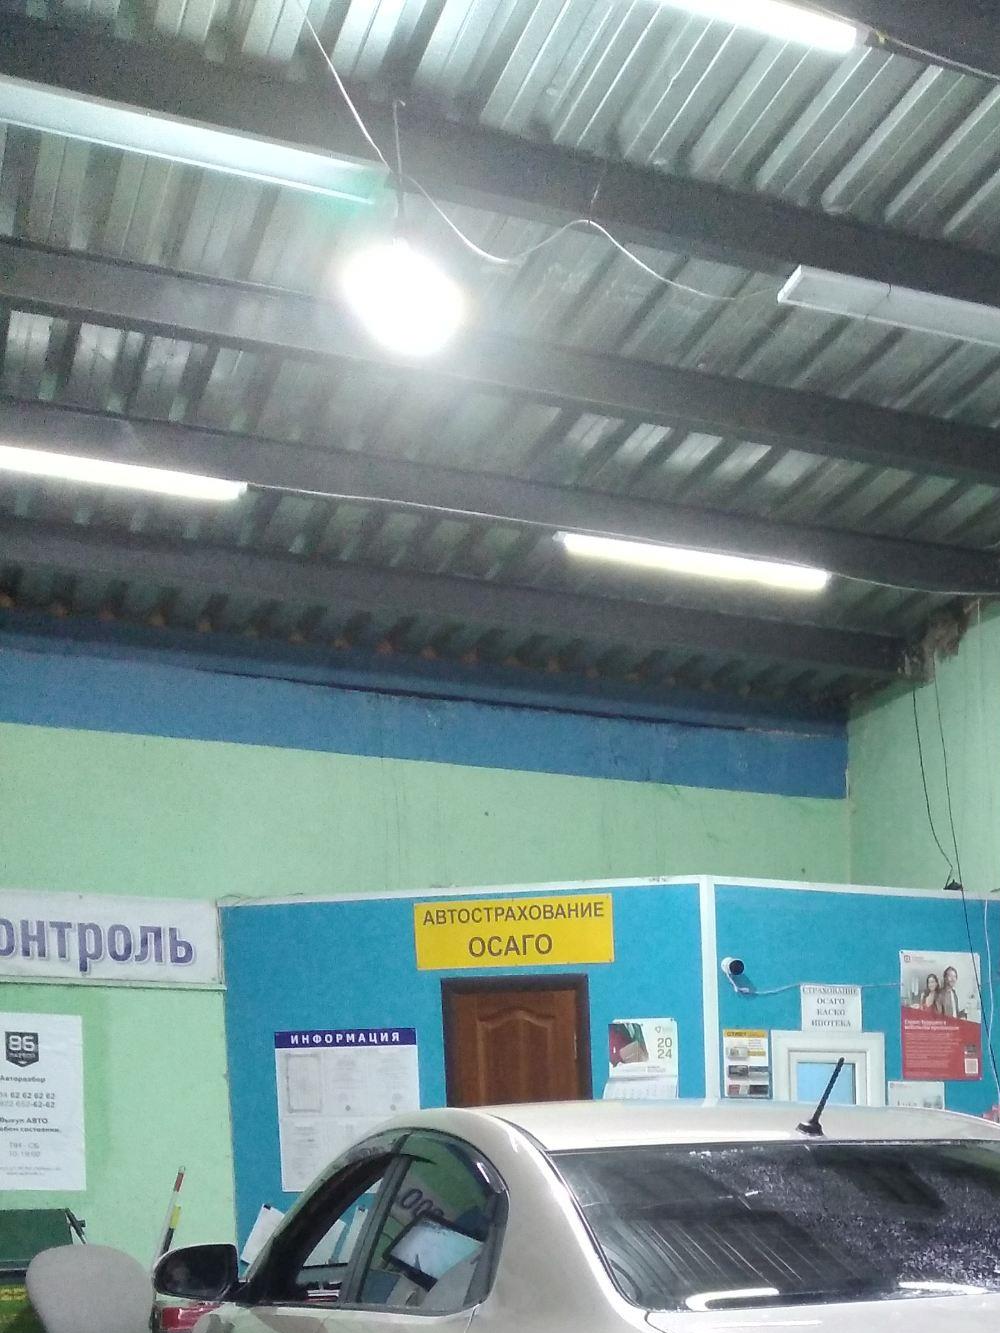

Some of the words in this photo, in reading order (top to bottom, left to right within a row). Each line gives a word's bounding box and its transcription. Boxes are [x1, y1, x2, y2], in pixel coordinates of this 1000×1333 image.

[422, 902, 605, 926] АВТОСТРАХОВАНИЕ
[468, 933, 553, 958] ОСАГО
[9, 1035, 35, 1052] 86
[290, 1031, 400, 1045] ИНФОРМАЦИЯ
[657, 1037, 673, 1048] 20
[657, 1049, 673, 1059] 24
